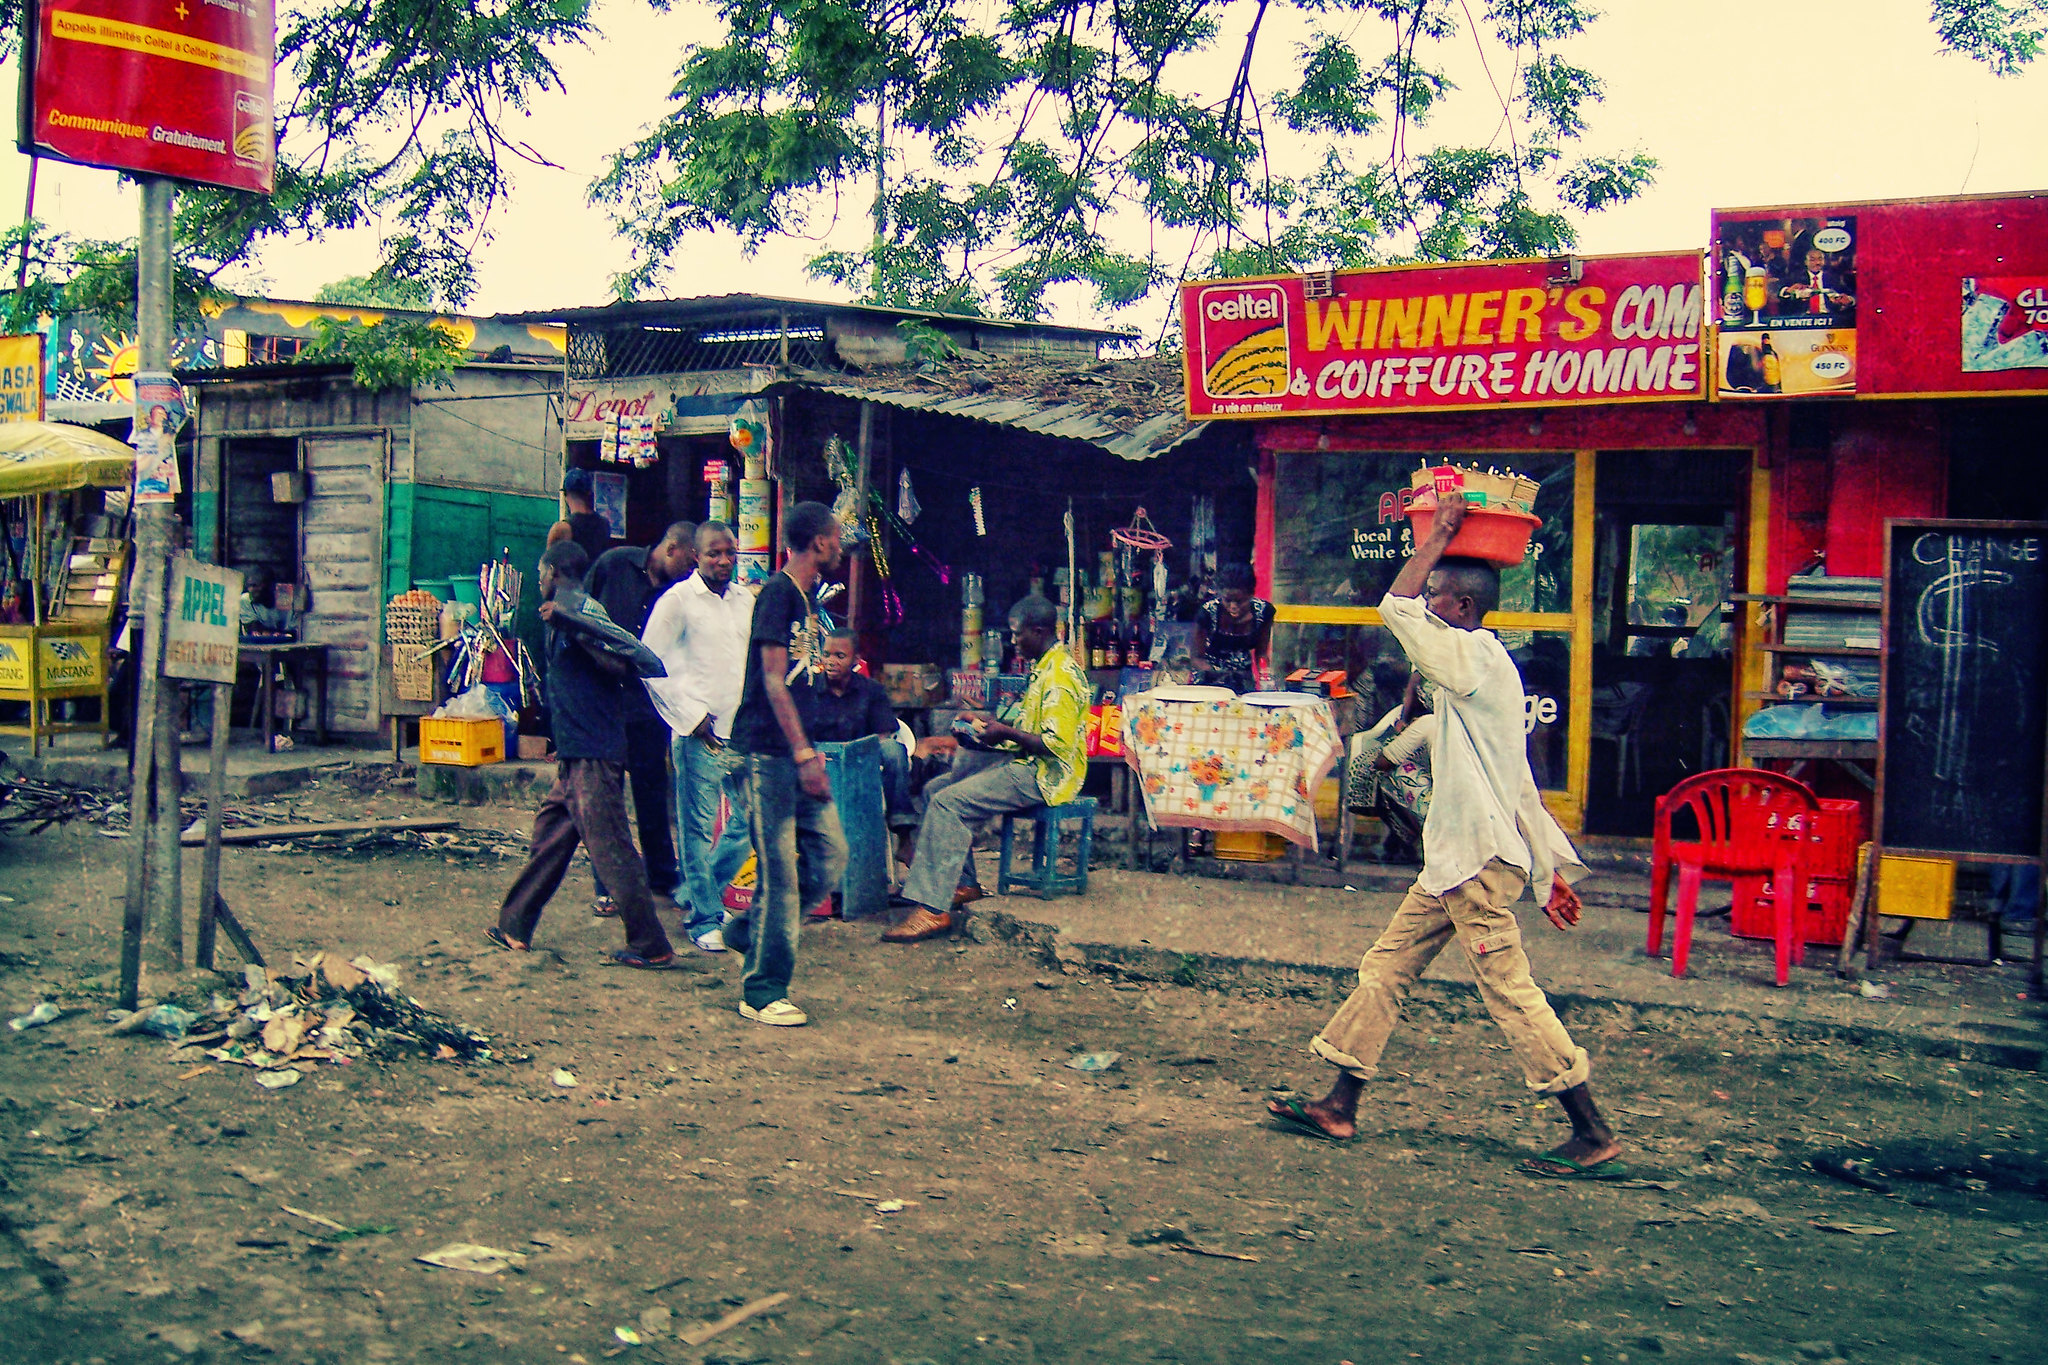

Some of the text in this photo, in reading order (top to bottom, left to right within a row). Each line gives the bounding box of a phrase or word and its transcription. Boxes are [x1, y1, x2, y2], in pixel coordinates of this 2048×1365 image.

[57, 19, 97, 34] Appels
[100, 26, 141, 43] illimités
[144, 35, 173, 50] Celtel
[183, 43, 209, 58] Celtel
[49, 109, 227, 155] Communiquer. Gratuitement.
[1836, 236, 1846, 244] FC
[1206, 292, 1279, 322] celtel
[1304, 283, 1700, 352] WINNER'S COM
[1769, 319, 1783, 328] EN
[1784, 318, 1813, 327] VENTE
[1290, 343, 1699, 399] & COIFFURE HOMME
[1815, 362, 1831, 370] 450
[0, 365, 35, 389] ASA
[1212, 401, 1283, 414] La vie en mieux
[1353, 527, 1412, 543] local &
[1351, 543, 1396, 560] Vente
[182, 575, 228, 627] APPEL
[46, 665, 94, 680] MUSTANG
